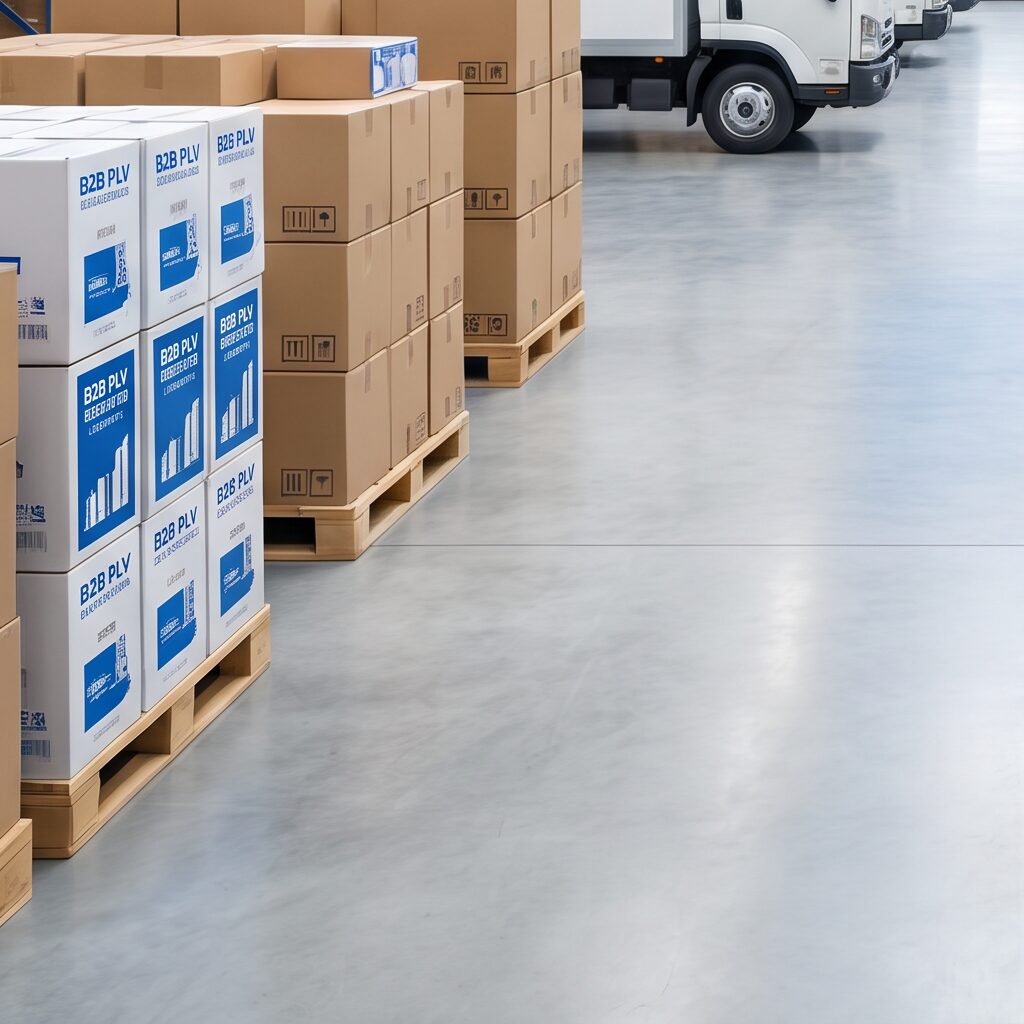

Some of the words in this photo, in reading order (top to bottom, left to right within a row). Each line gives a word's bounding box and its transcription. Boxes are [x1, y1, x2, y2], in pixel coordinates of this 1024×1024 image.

[236, 127, 255, 147] PLV
[155, 150, 177, 174] B2B
[179, 143, 201, 167] PLV
[79, 171, 105, 197] B2B
[107, 163, 131, 188] PLV
[160, 343, 180, 367] B2B
[181, 332, 199, 356] PLV
[83, 377, 106, 406] B2B
[108, 367, 129, 392] PLV
[238, 462, 255, 490] PLV
[154, 521, 175, 552] B2B
[178, 505, 198, 534] PLV
[79, 570, 106, 607] B2B
[108, 552, 132, 586] PLV
